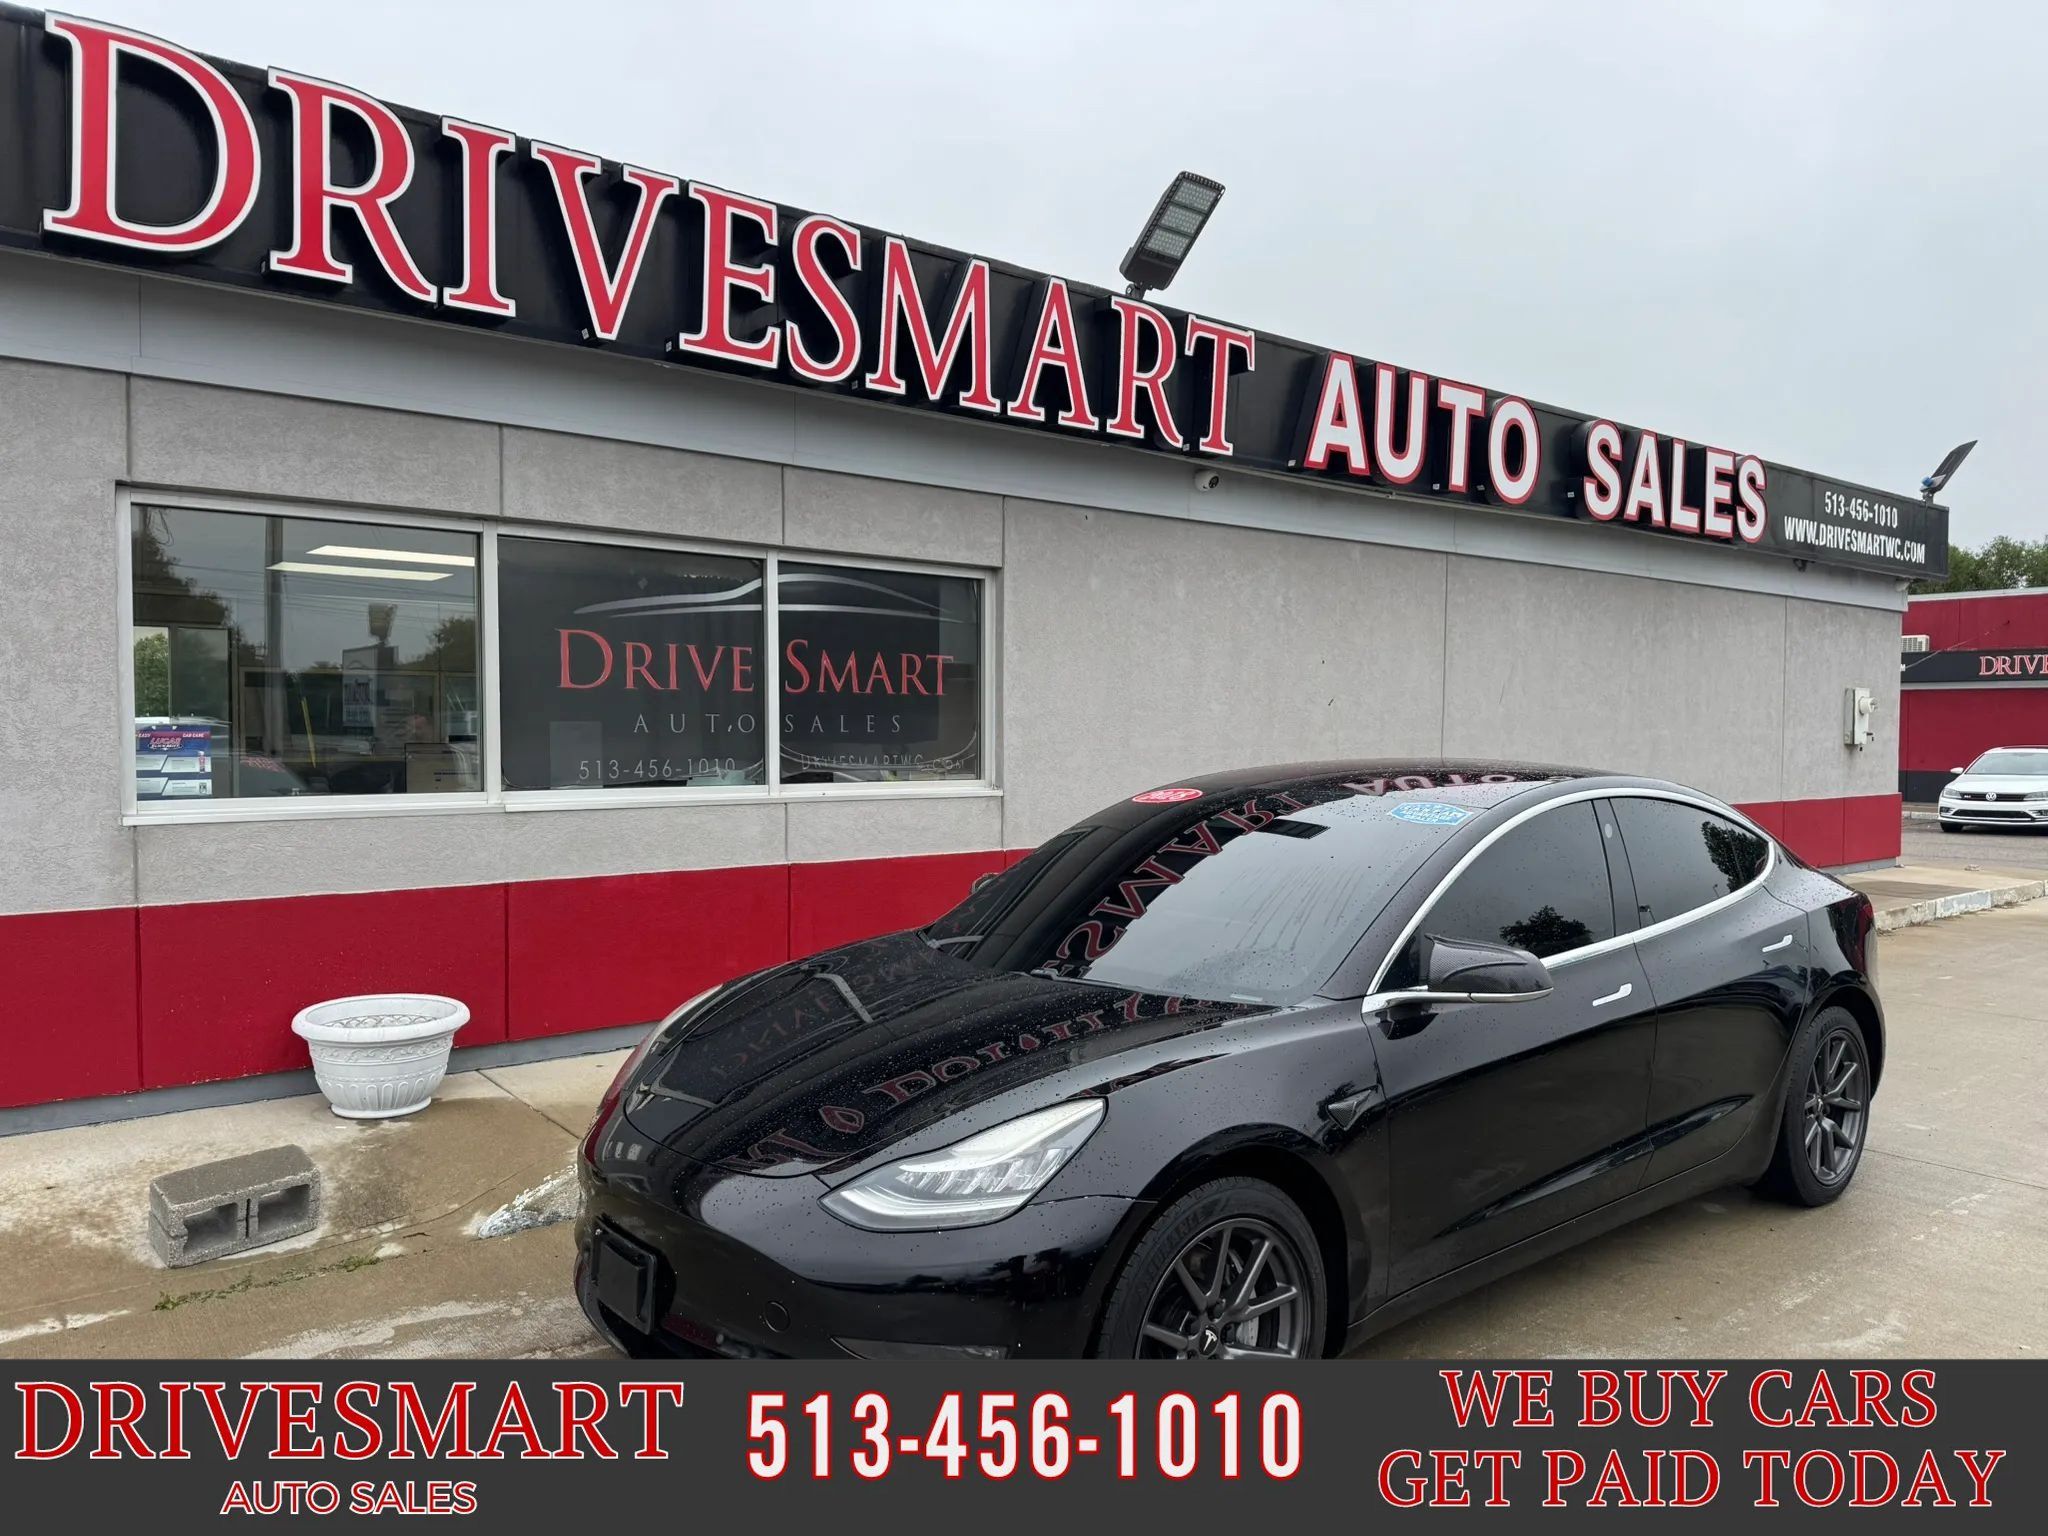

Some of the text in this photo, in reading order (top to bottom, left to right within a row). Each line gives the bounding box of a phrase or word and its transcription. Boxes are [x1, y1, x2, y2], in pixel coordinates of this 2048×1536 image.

[43, 10, 1768, 544] DRIVESMART AUTO SALES
[1824, 491, 1898, 529] 513-456-1010
[1784, 516, 1926, 564] WWW.DRIVESMARTWC.COM
[556, 628, 954, 697] DRIVE SMART
[633, 713, 901, 734] AUTO SALES
[579, 758, 736, 780] 513-456-1010
